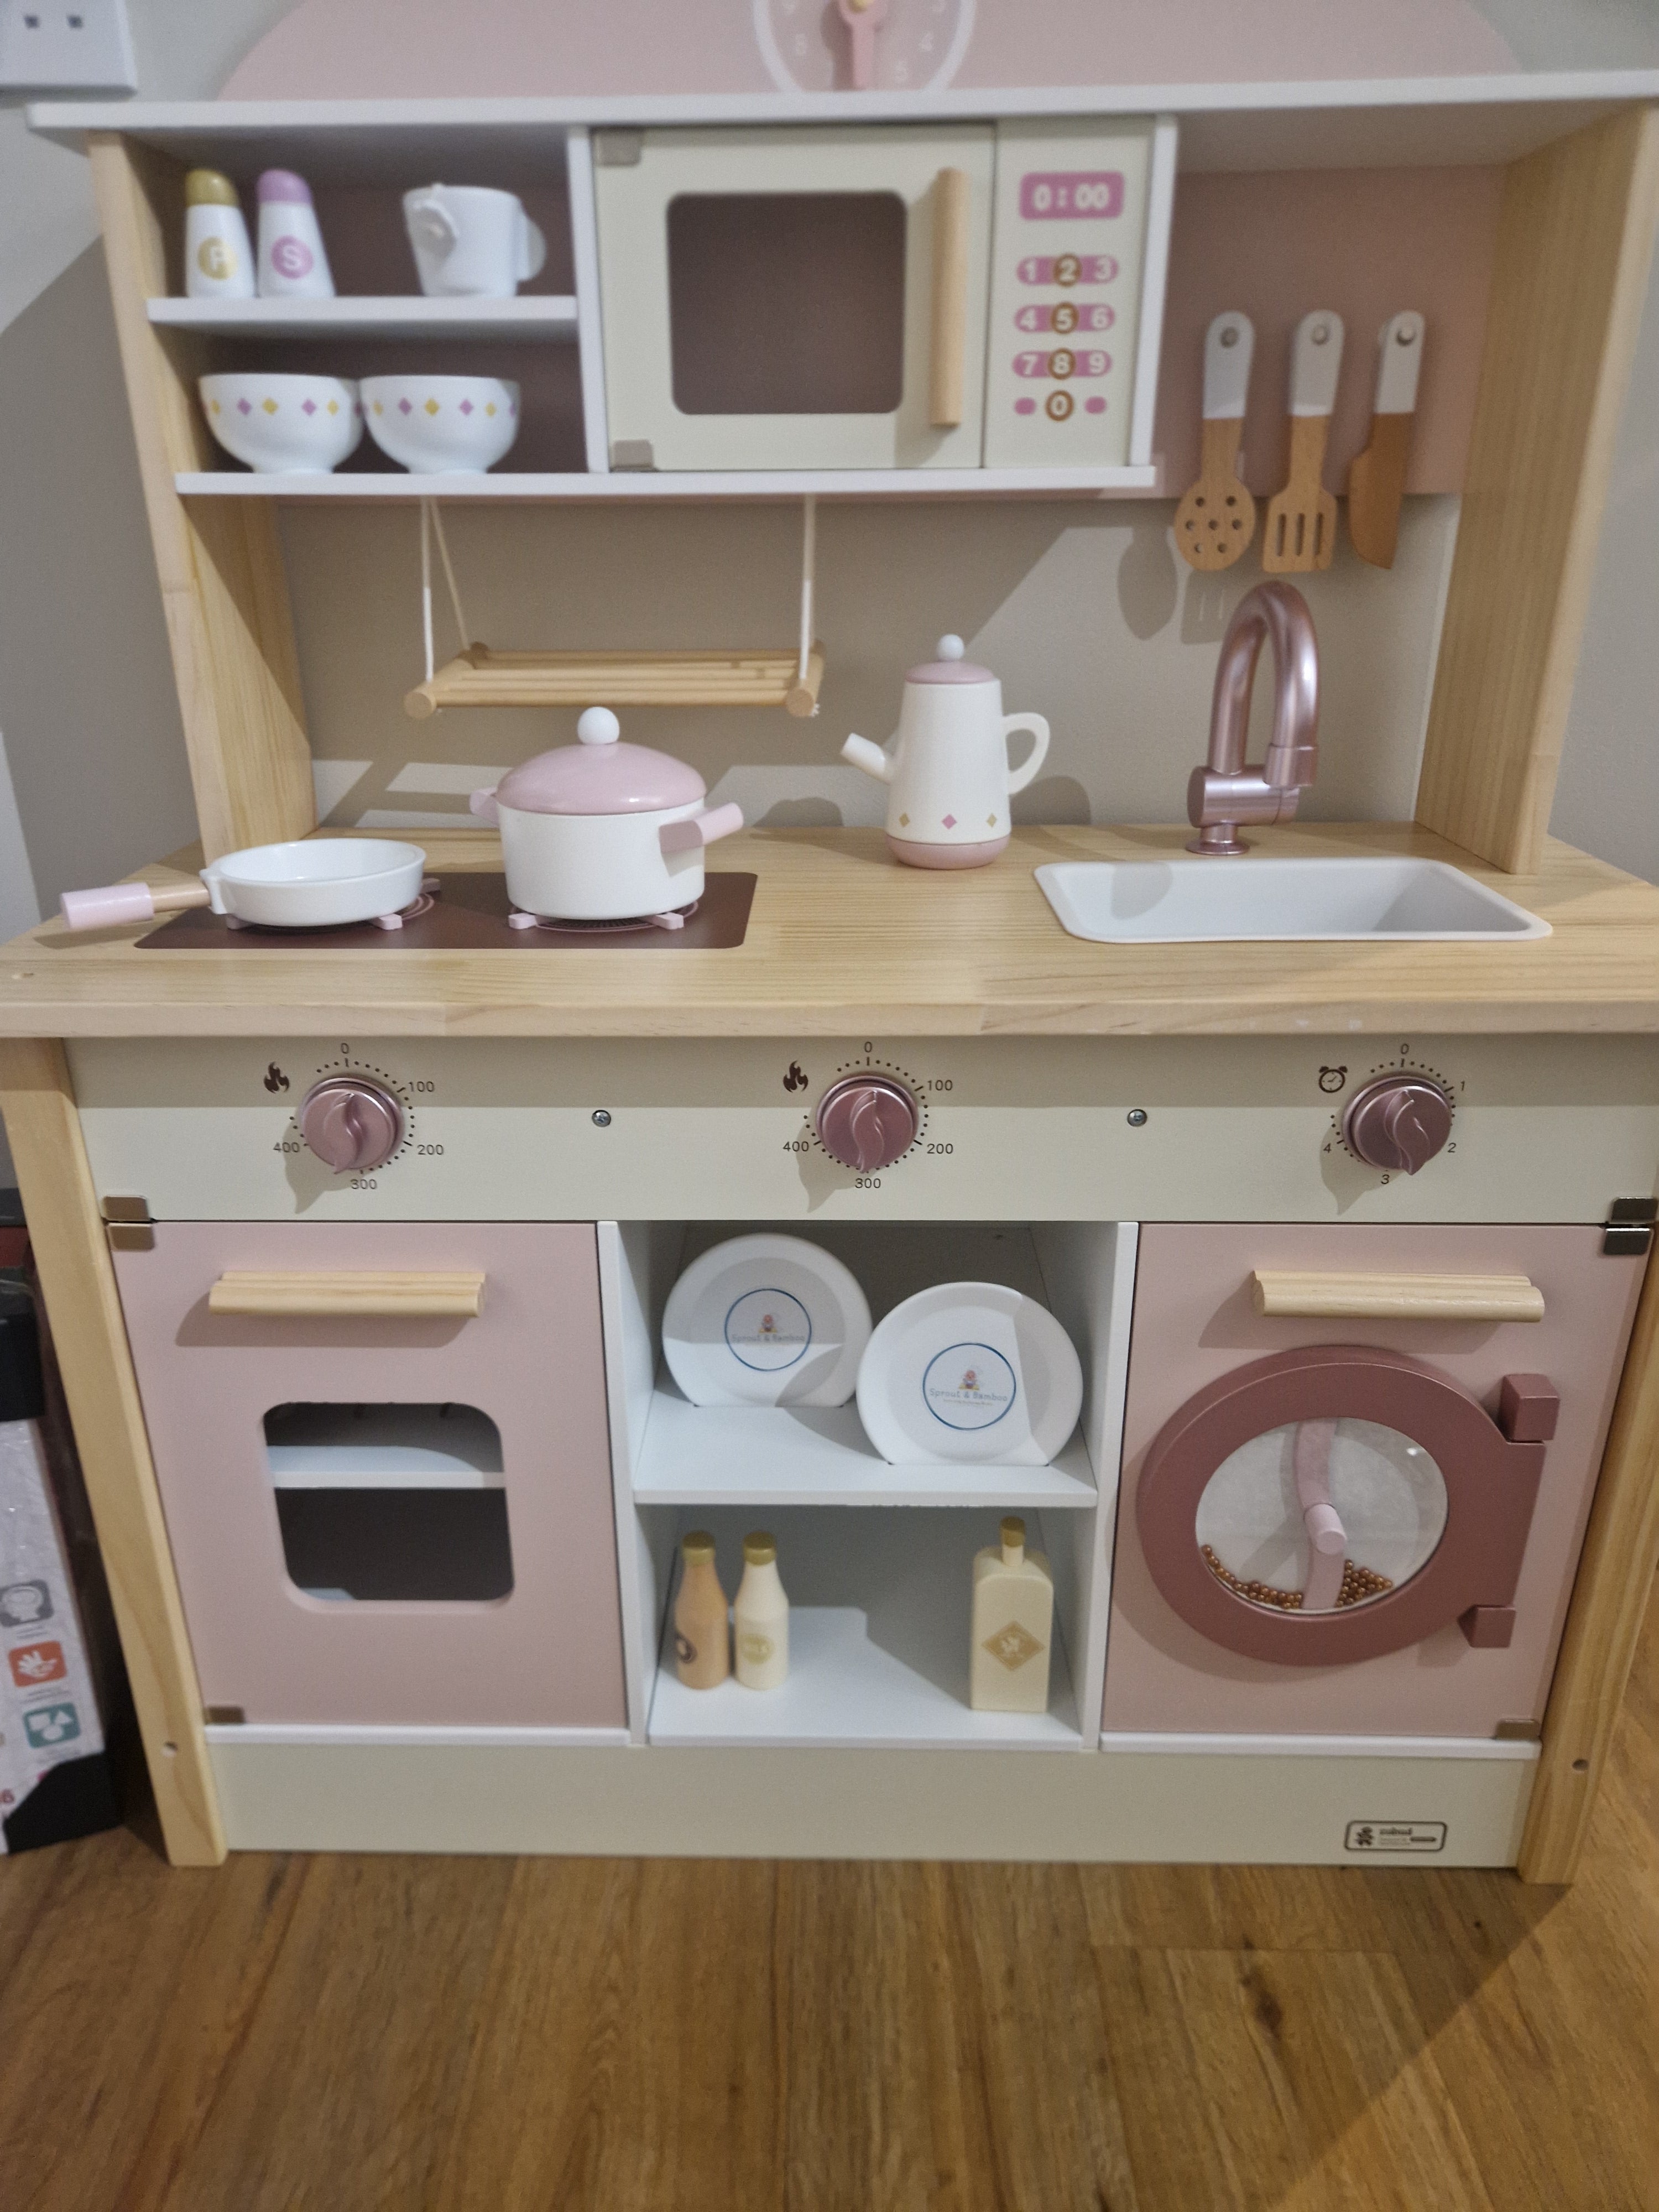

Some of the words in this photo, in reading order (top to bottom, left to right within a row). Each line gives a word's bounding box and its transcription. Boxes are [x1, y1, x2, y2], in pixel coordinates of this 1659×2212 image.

[1033, 183, 1109, 211] 0:00
[281, 245, 302, 270] S
[1025, 260, 1036, 281] 1
[1060, 259, 1077, 281] 2
[1094, 258, 1111, 280] 3
[1020, 307, 1036, 330] 4
[1057, 308, 1073, 331] 5
[1091, 306, 1109, 329] 6
[1023, 354, 1038, 375] 7
[1053, 353, 1071, 374] 8
[1088, 352, 1105, 374] 9
[1052, 395, 1067, 415] 0
[341, 1042, 349, 1054] 0
[864, 1041, 873, 1053] 0
[1400, 1043, 1410, 1055] 0
[408, 1081, 435, 1093] 100
[927, 1079, 953, 1091] 100
[1460, 1081, 1465, 1091] 1
[273, 1141, 300, 1154] 400
[418, 1144, 444, 1155] 200
[782, 1141, 810, 1152] 400
[926, 1143, 953, 1155] 200
[1323, 1142, 1332, 1154] 4
[1447, 1142, 1457, 1153] 2
[351, 1178, 378, 1190] 300
[854, 1178, 881, 1189] 300
[1381, 1174, 1390, 1185] 3
[930, 1388, 961, 1398] Sprout
[973, 1391, 1008, 1402] Bamboo
